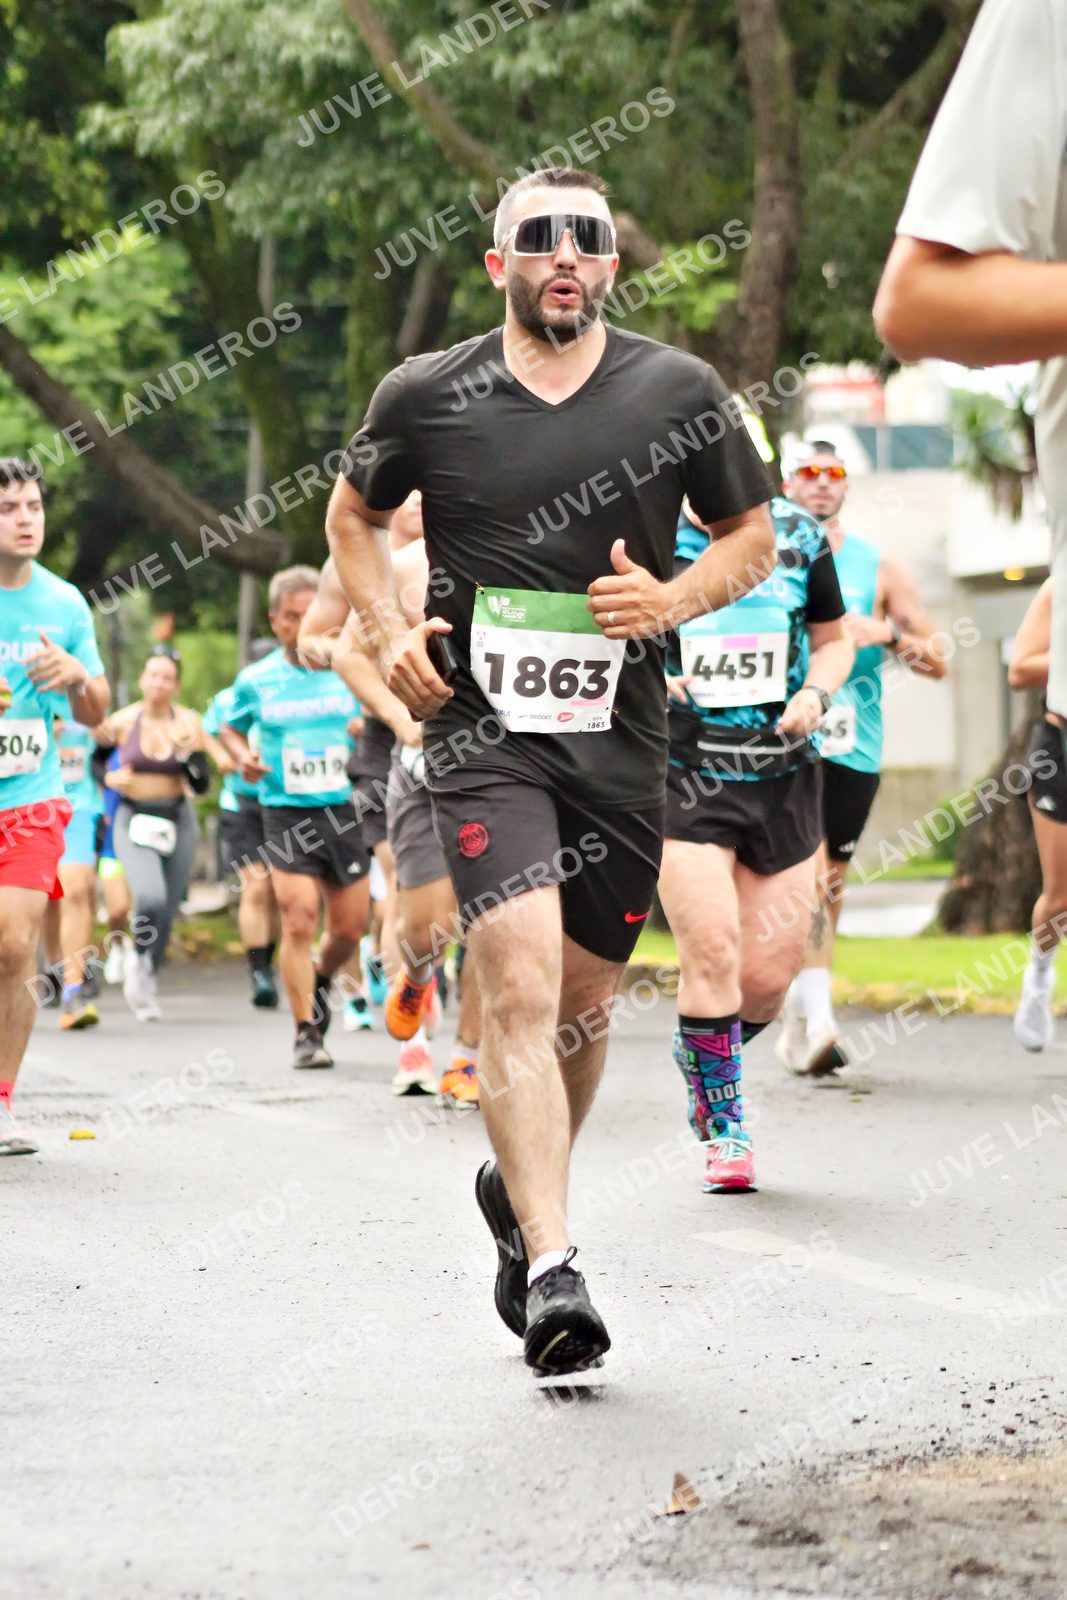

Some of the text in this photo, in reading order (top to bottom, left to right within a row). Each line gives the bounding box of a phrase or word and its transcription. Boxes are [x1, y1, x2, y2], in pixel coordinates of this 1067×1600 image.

[484, 652, 611, 700] 1863
[692, 652, 774, 681] 4451
[586, 721, 605, 729] 1863
